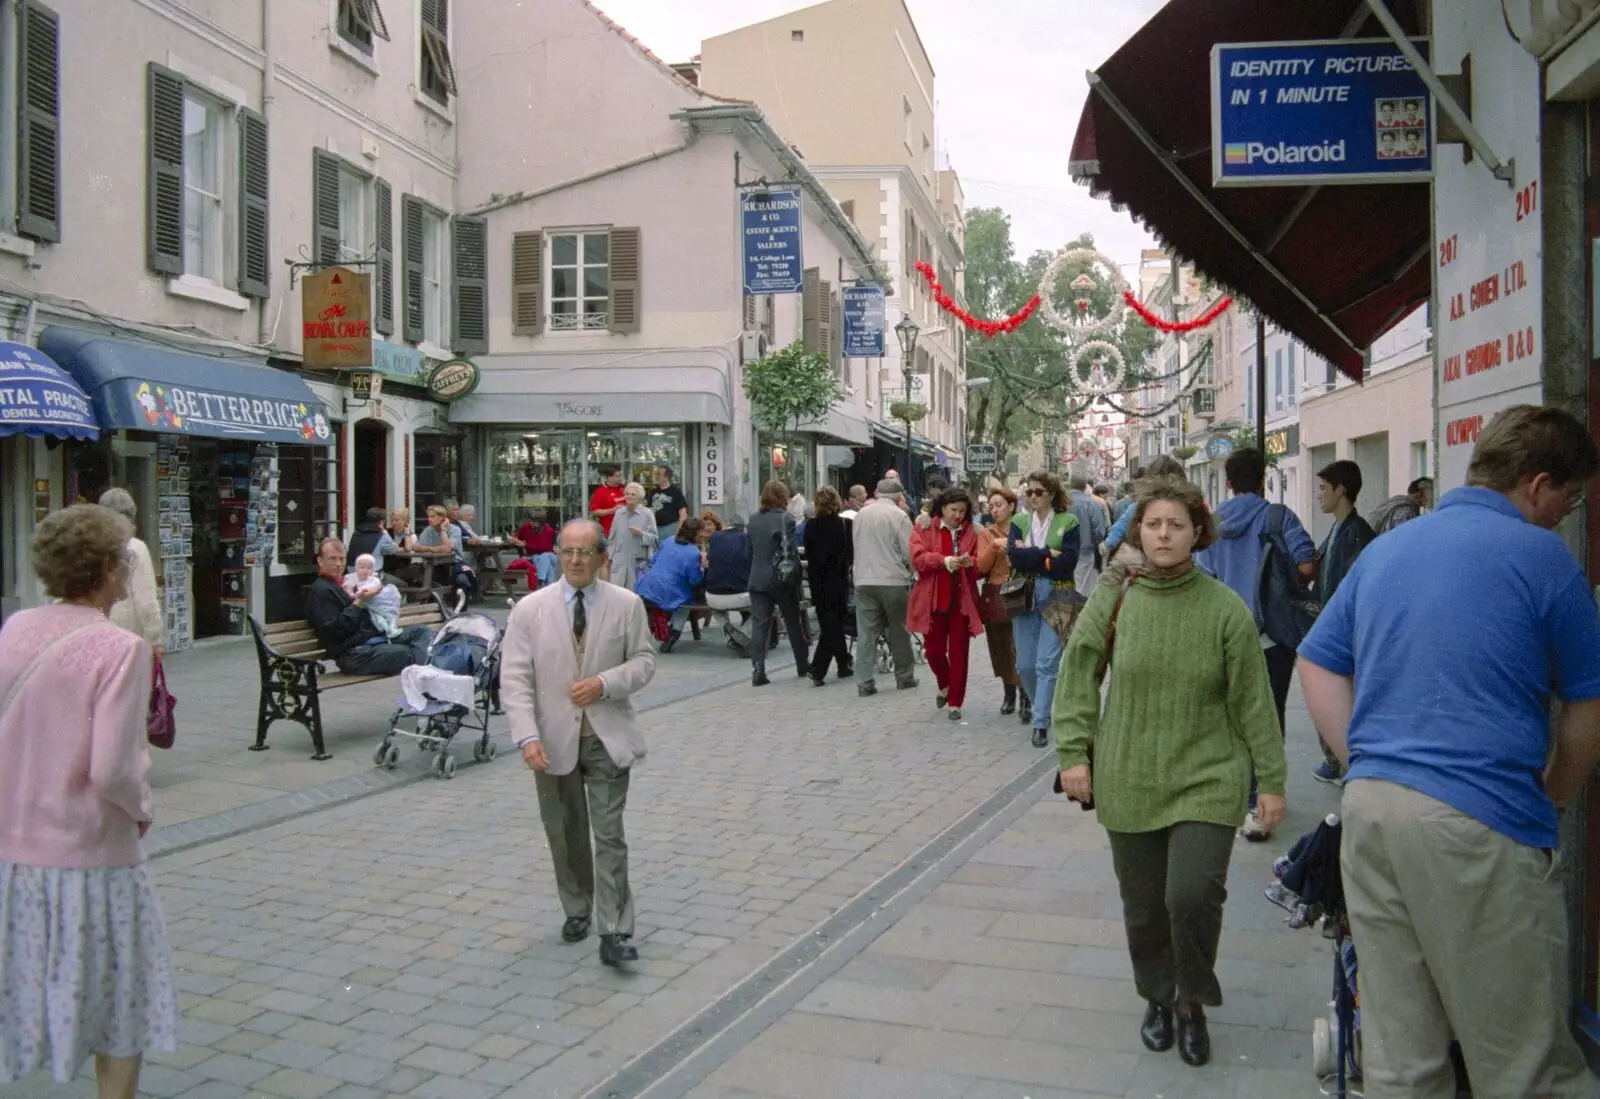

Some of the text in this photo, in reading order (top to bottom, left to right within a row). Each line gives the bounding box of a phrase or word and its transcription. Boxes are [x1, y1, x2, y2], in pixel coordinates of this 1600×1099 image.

[1230, 58, 1315, 77] IDENTITY
[1231, 86, 1351, 104] IN 1 MINUTE
[1247, 139, 1346, 164] Polaroid
[744, 200, 799, 212] RICHARDSON
[1516, 180, 1538, 222] 207
[746, 225, 798, 235] ESTATE AGENTS
[756, 241, 788, 249] VALUERS
[1440, 233, 1458, 268] 207
[43, 389, 91, 417] PRACTICE
[171, 388, 303, 428] BETTERPRICE
[554, 402, 604, 419] TAGORE
[2, 408, 42, 418] DENTAL
[706, 423, 718, 500] TAGORE
